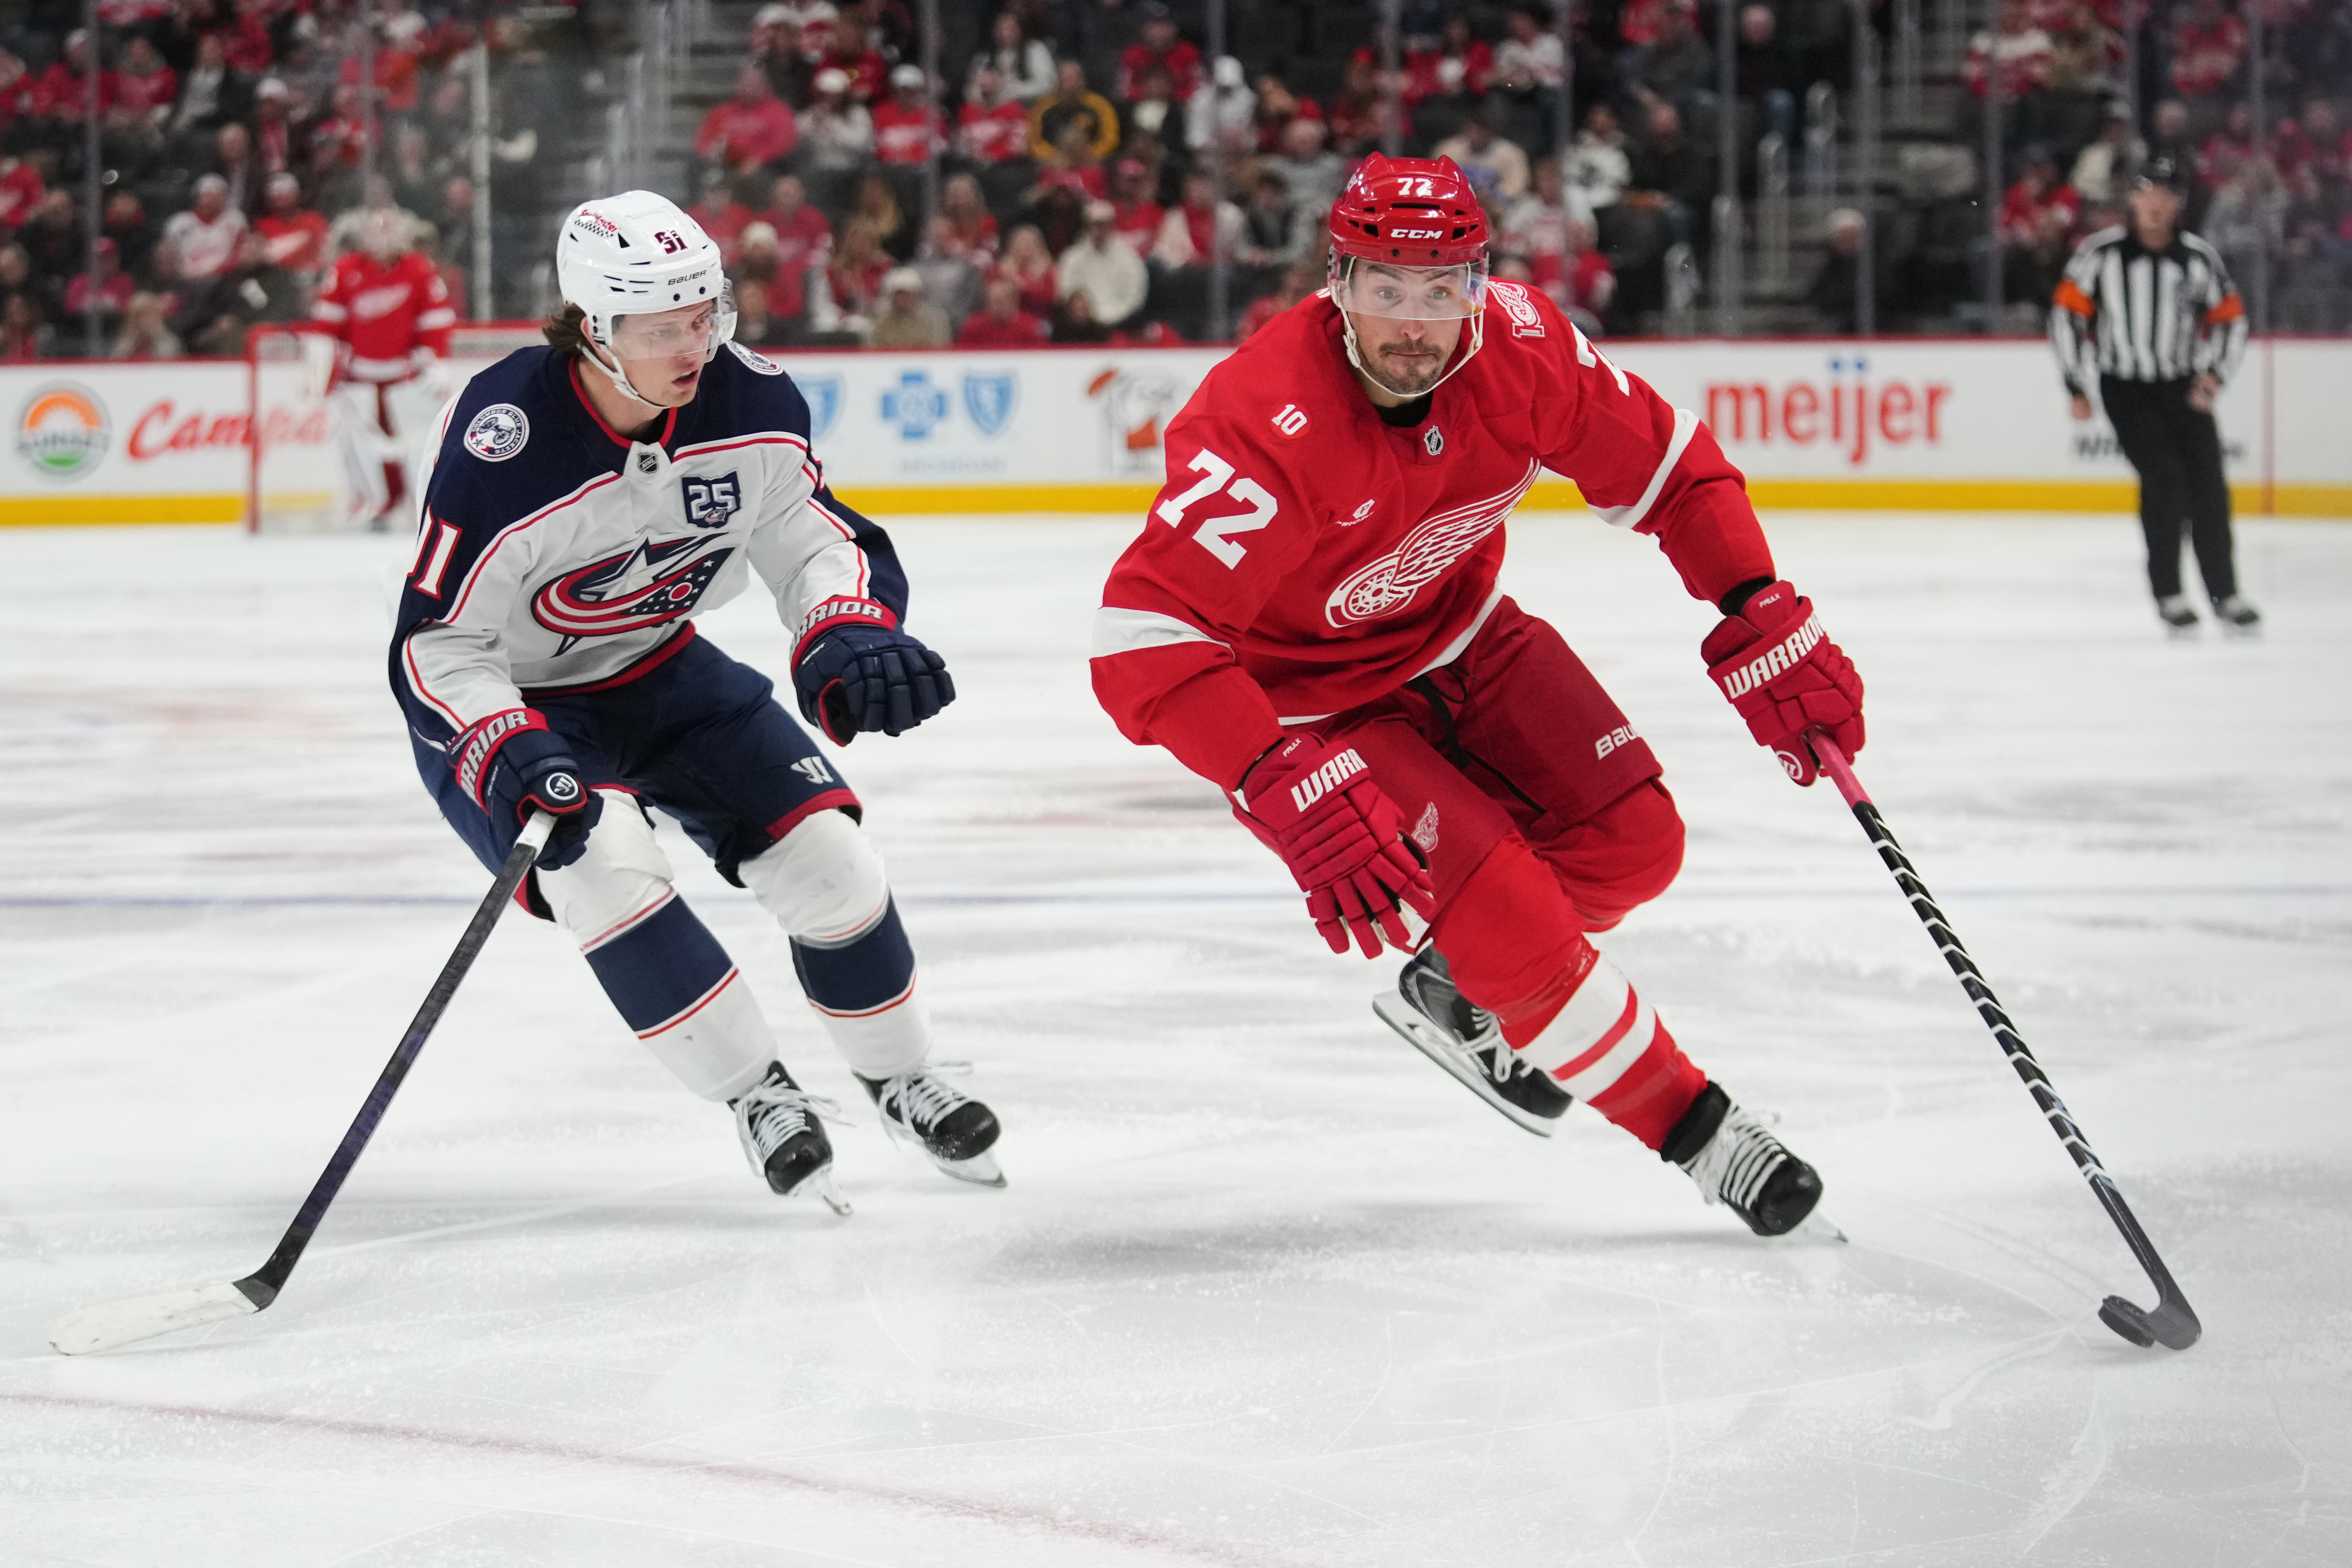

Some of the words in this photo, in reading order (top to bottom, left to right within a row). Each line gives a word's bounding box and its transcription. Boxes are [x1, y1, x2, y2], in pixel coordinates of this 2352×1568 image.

[1397, 178, 1432, 196] 72
[1390, 229, 1443, 239] CCM
[668, 269, 707, 285] BAUER
[472, 409, 507, 432] COLUMBUS
[507, 411, 522, 429] BLUE
[1271, 404, 1308, 435] 10
[1705, 358, 1951, 466] meijer
[494, 429, 522, 455] JACKETS
[688, 482, 737, 519] 25
[1156, 447, 1278, 570] 72
[1759, 593, 1781, 608] FAULK
[1283, 738, 1302, 757] FAULK
